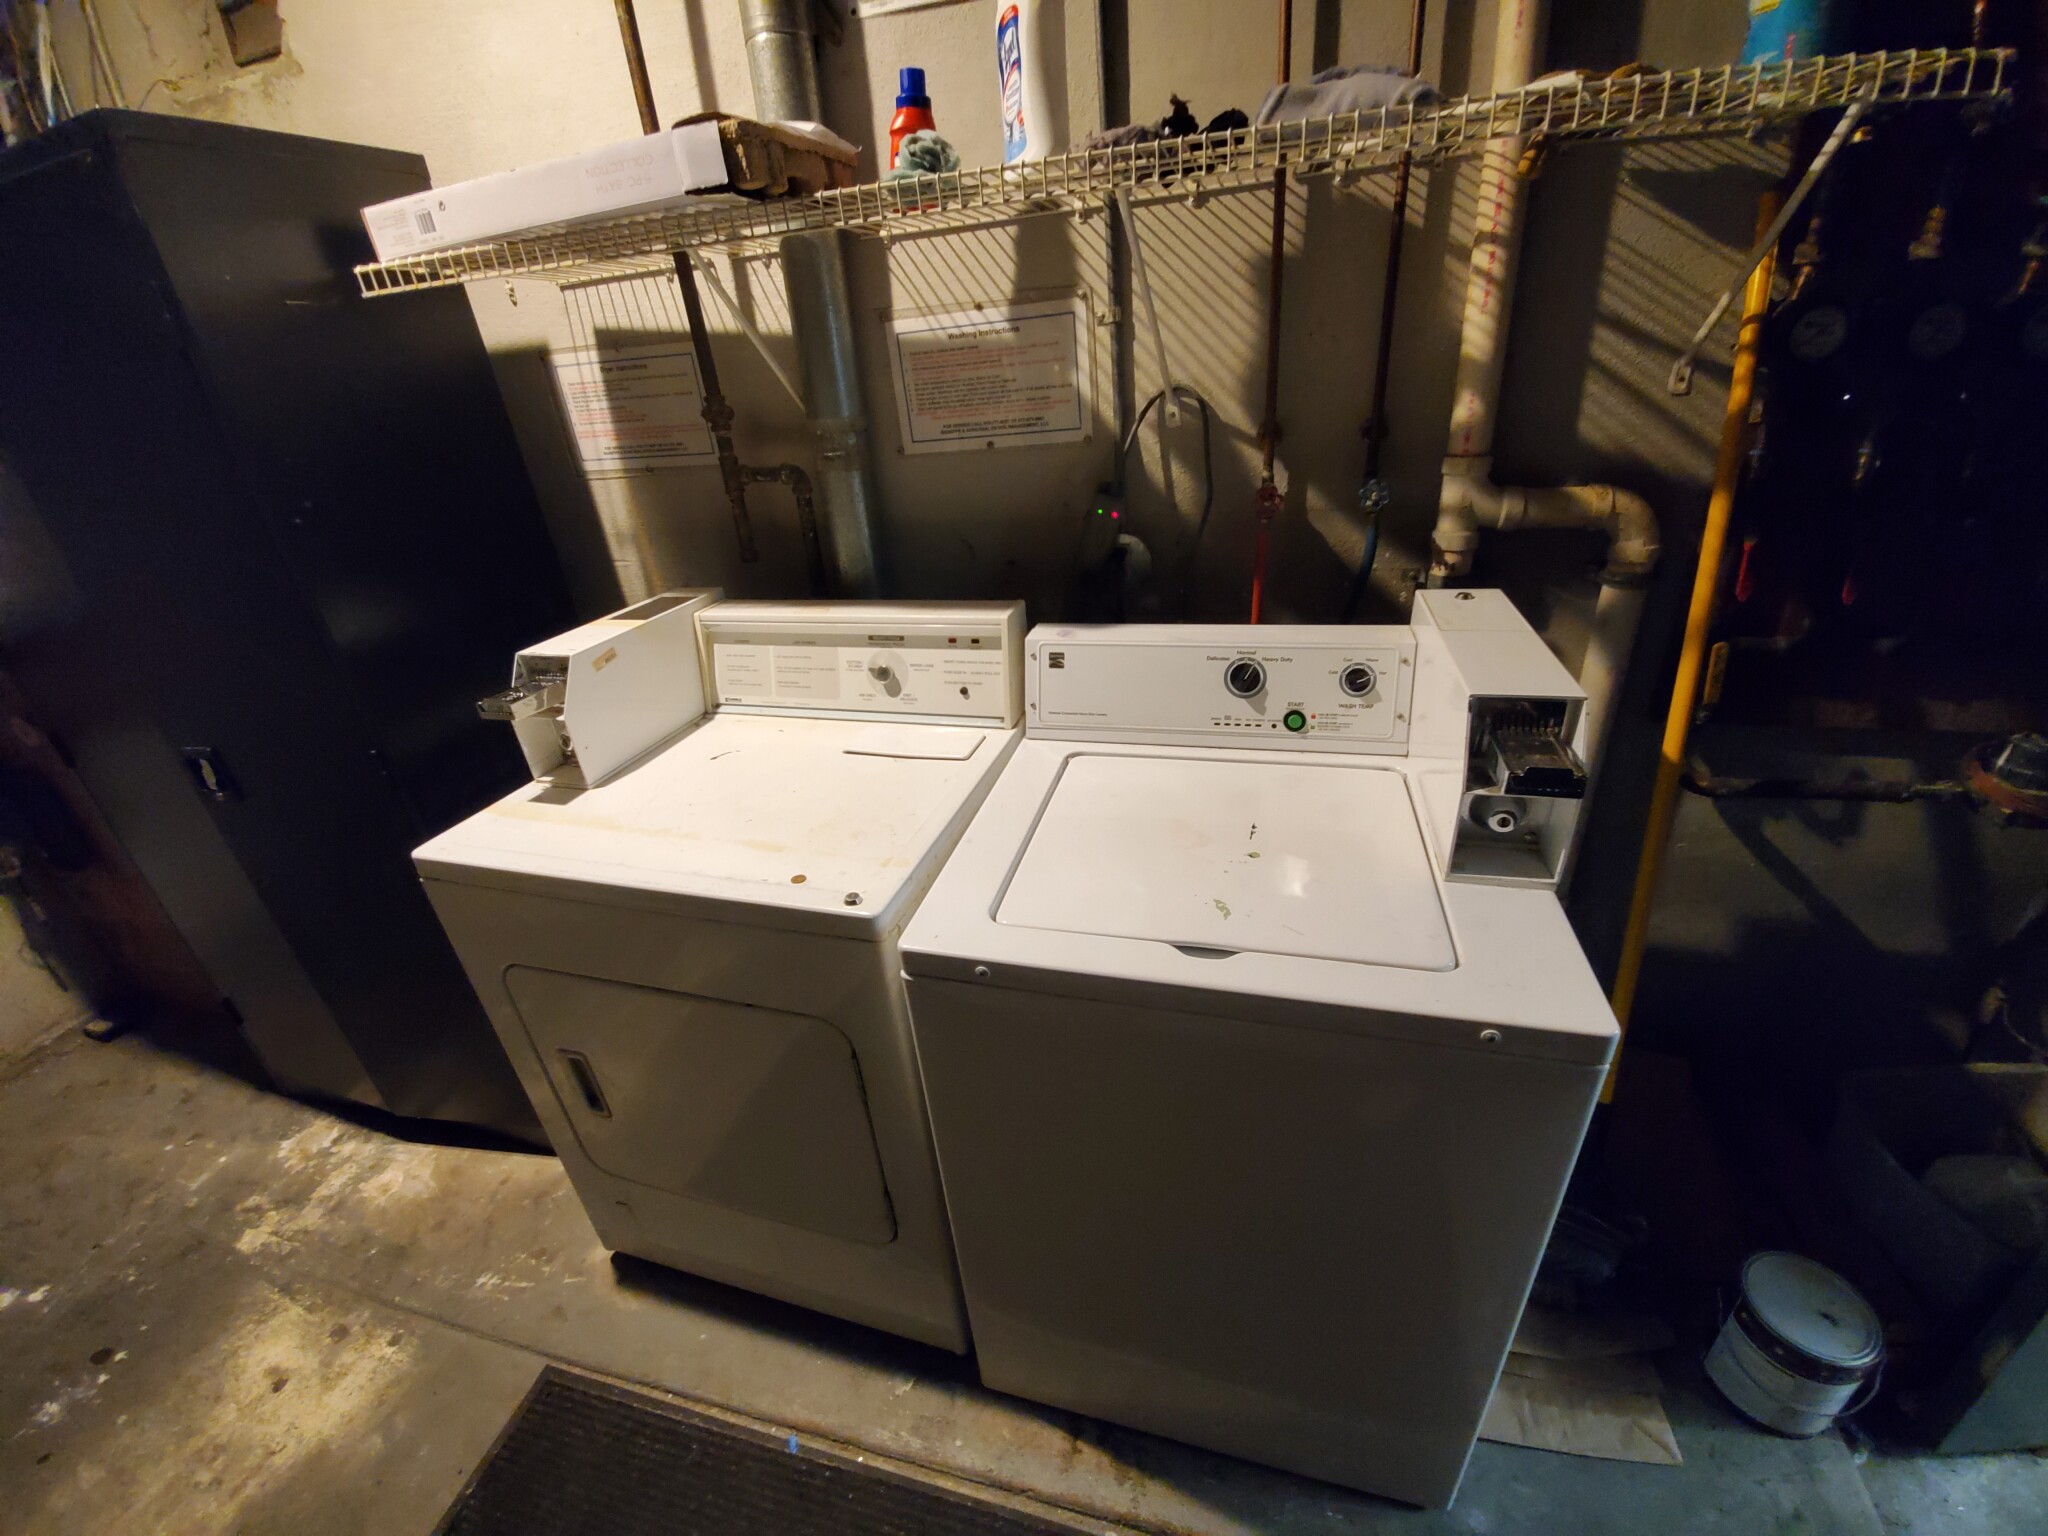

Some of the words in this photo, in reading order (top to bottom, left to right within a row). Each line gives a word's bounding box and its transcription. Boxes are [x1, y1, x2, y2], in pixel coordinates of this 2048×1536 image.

[585, 153, 654, 178] COLLECTION
[948, 330, 977, 340] Washing
[978, 326, 1020, 337] Instructions
